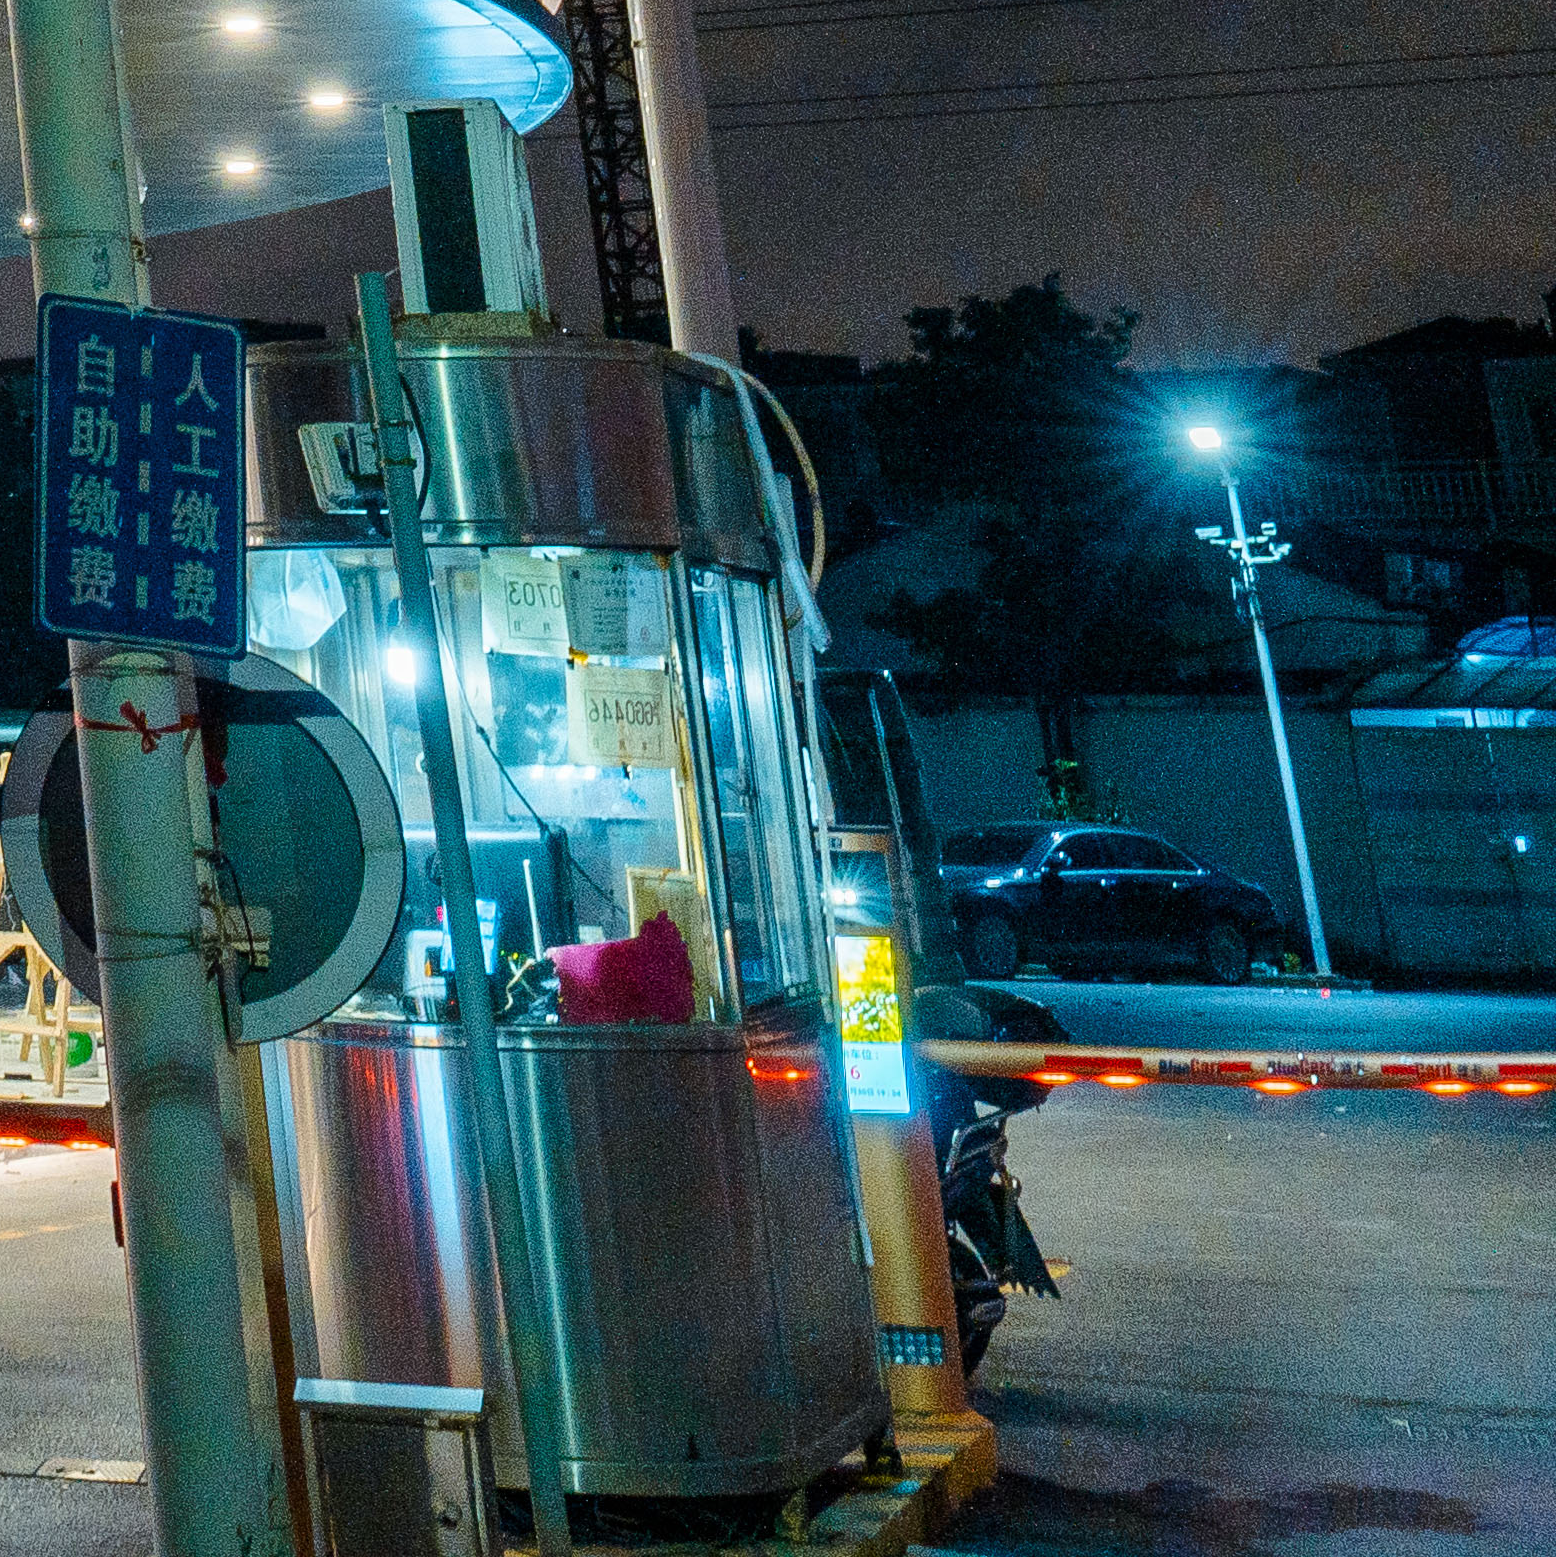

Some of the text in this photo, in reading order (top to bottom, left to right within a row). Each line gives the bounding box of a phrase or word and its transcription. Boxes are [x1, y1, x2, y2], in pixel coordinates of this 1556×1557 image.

[67, 333, 120, 611] 自助缴费
[171, 352, 220, 626] 人工缴费
